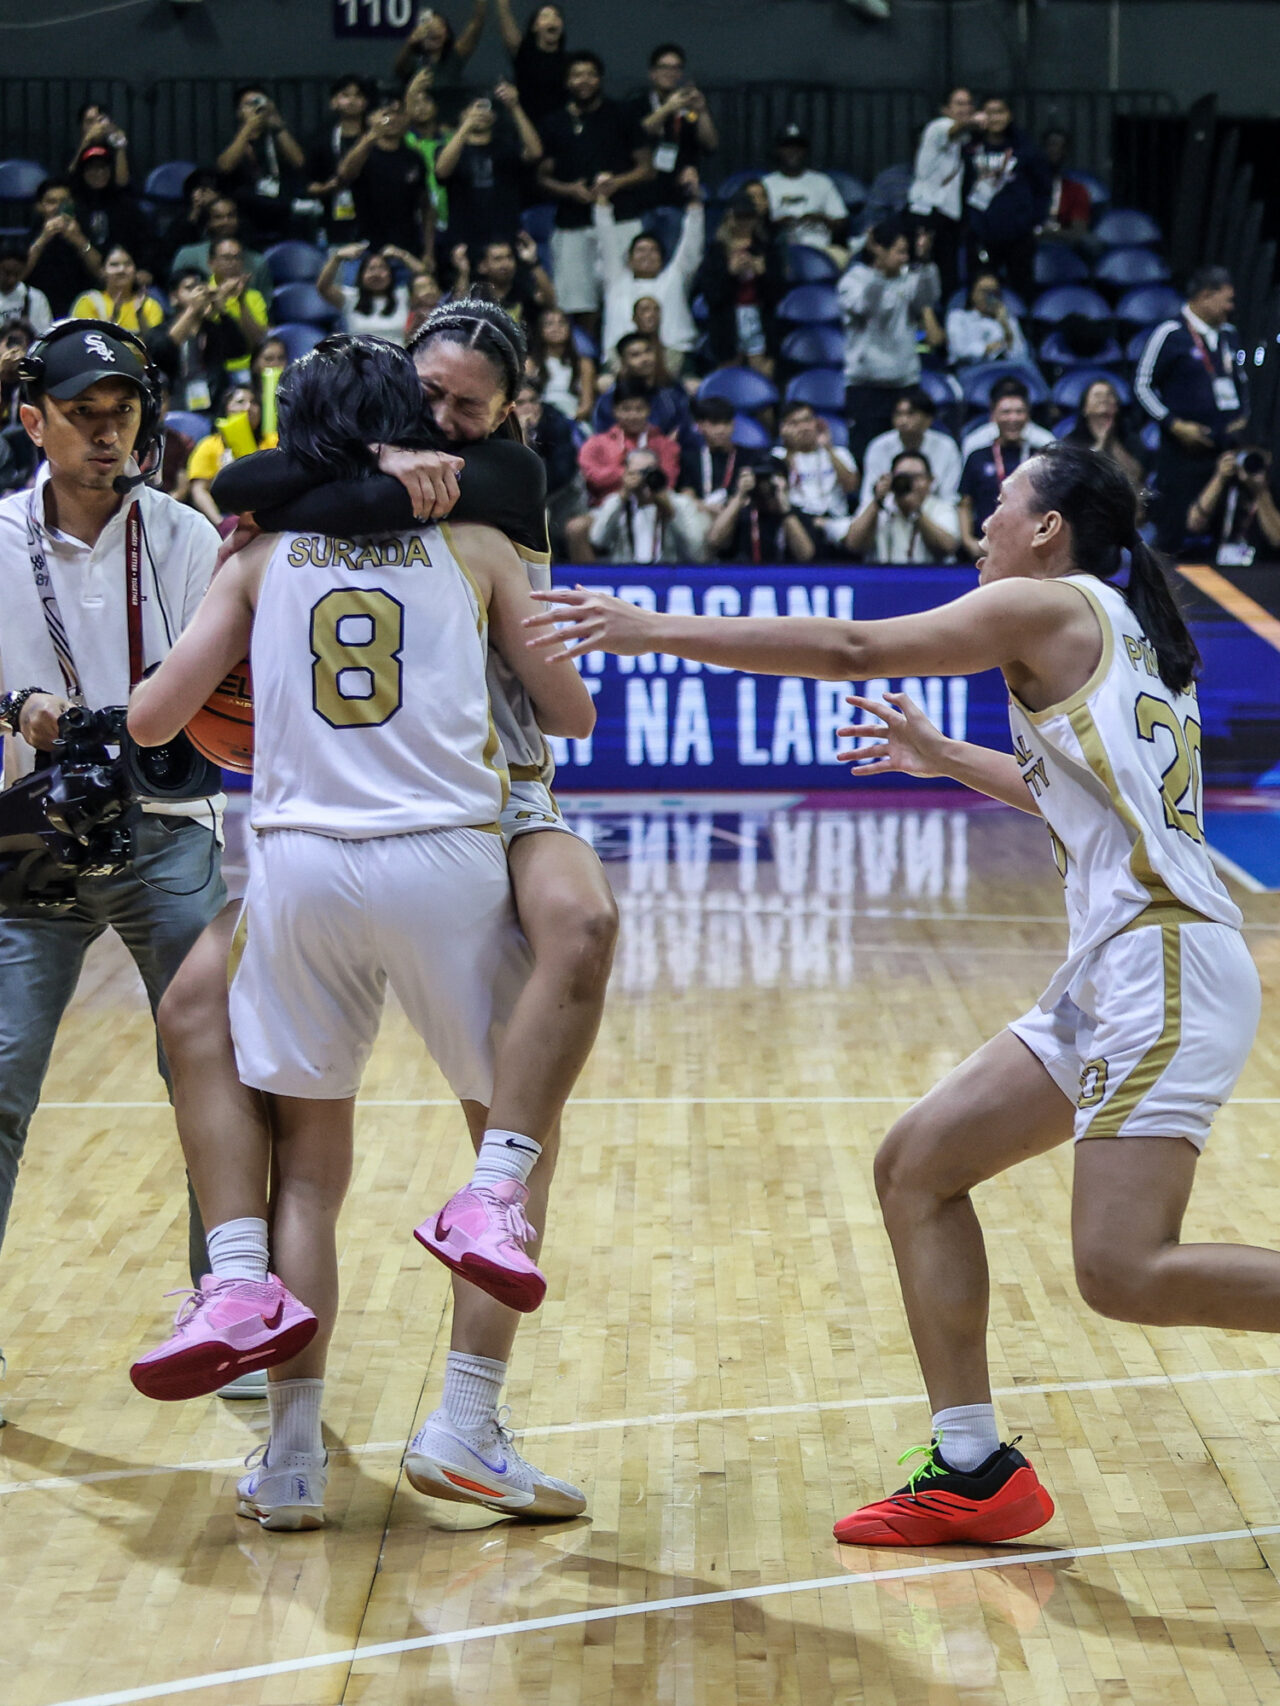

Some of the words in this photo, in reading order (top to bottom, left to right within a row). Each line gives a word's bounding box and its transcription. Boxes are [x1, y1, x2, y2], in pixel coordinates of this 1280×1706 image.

[338, 0, 412, 28] 110
[288, 536, 433, 571] SURADA
[309, 586, 405, 730] 8
[626, 677, 714, 766] NA
